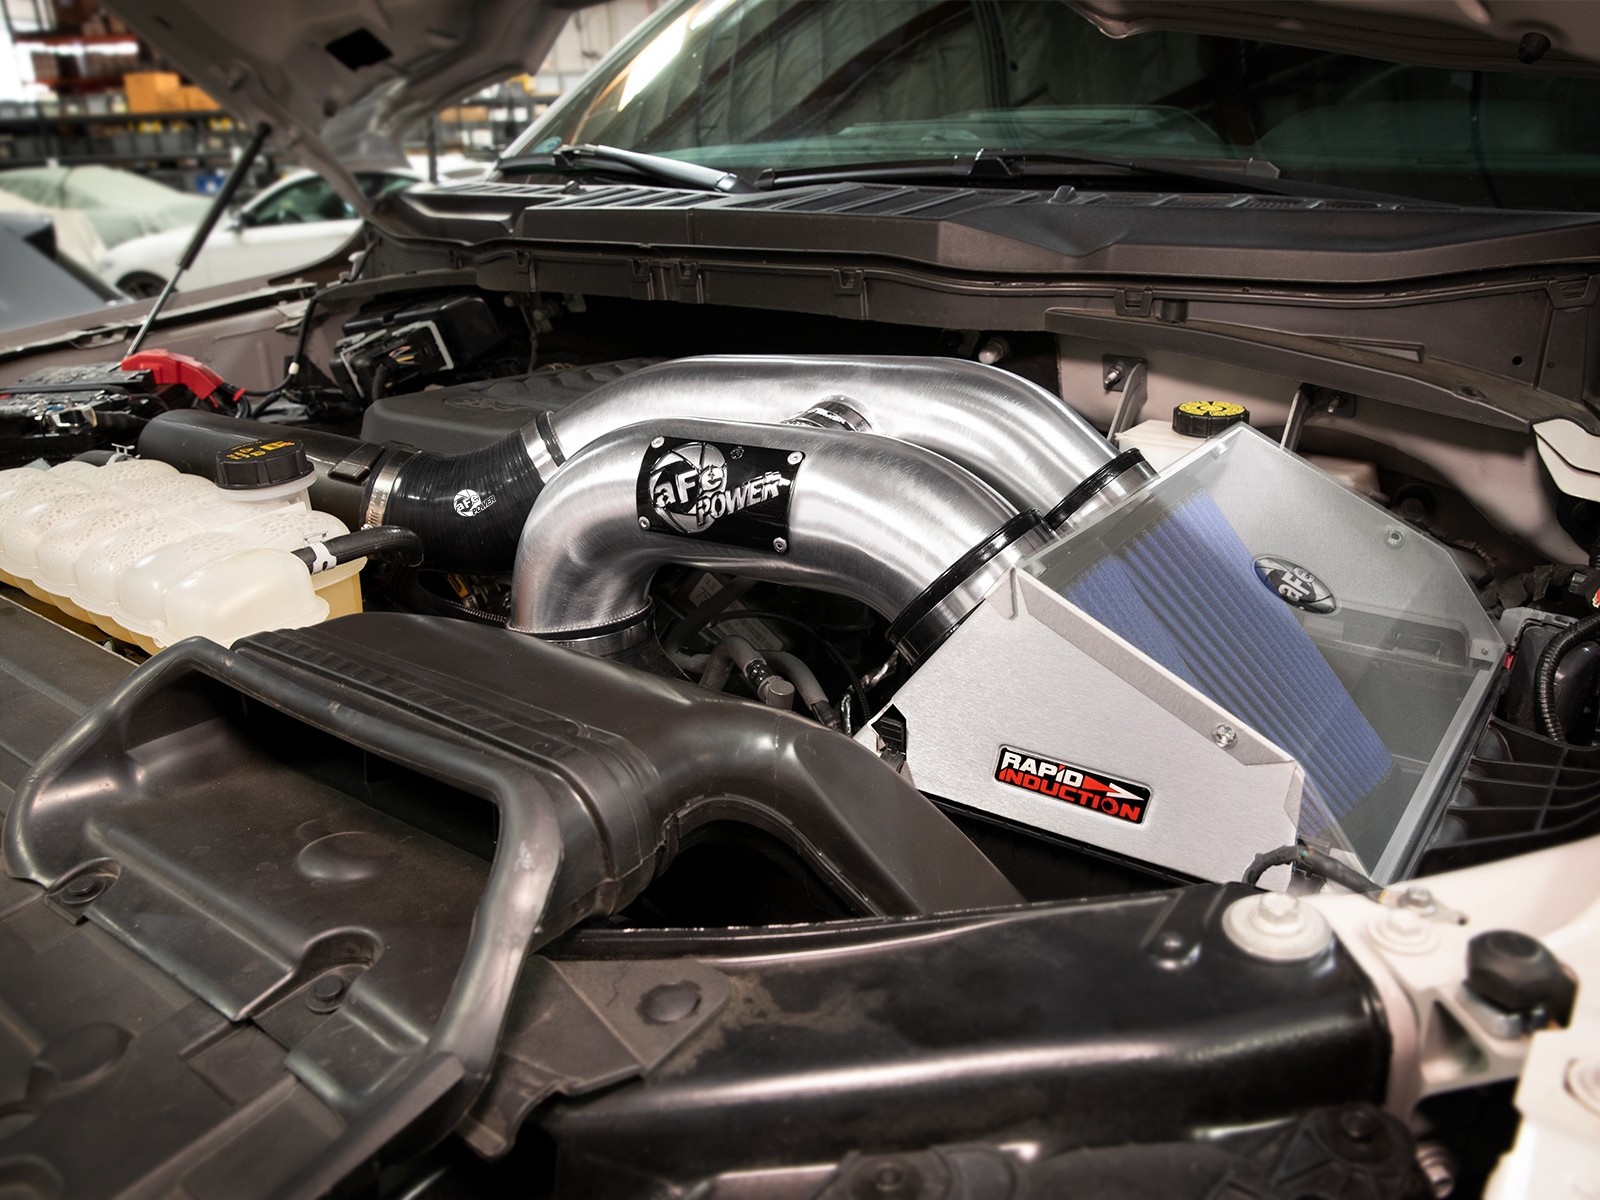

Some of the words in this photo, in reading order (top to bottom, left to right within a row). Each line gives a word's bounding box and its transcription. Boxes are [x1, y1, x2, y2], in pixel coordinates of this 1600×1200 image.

[472, 494, 497, 516] POWER
[695, 471, 790, 526] POWER
[999, 768, 1141, 821] INDUCTION
